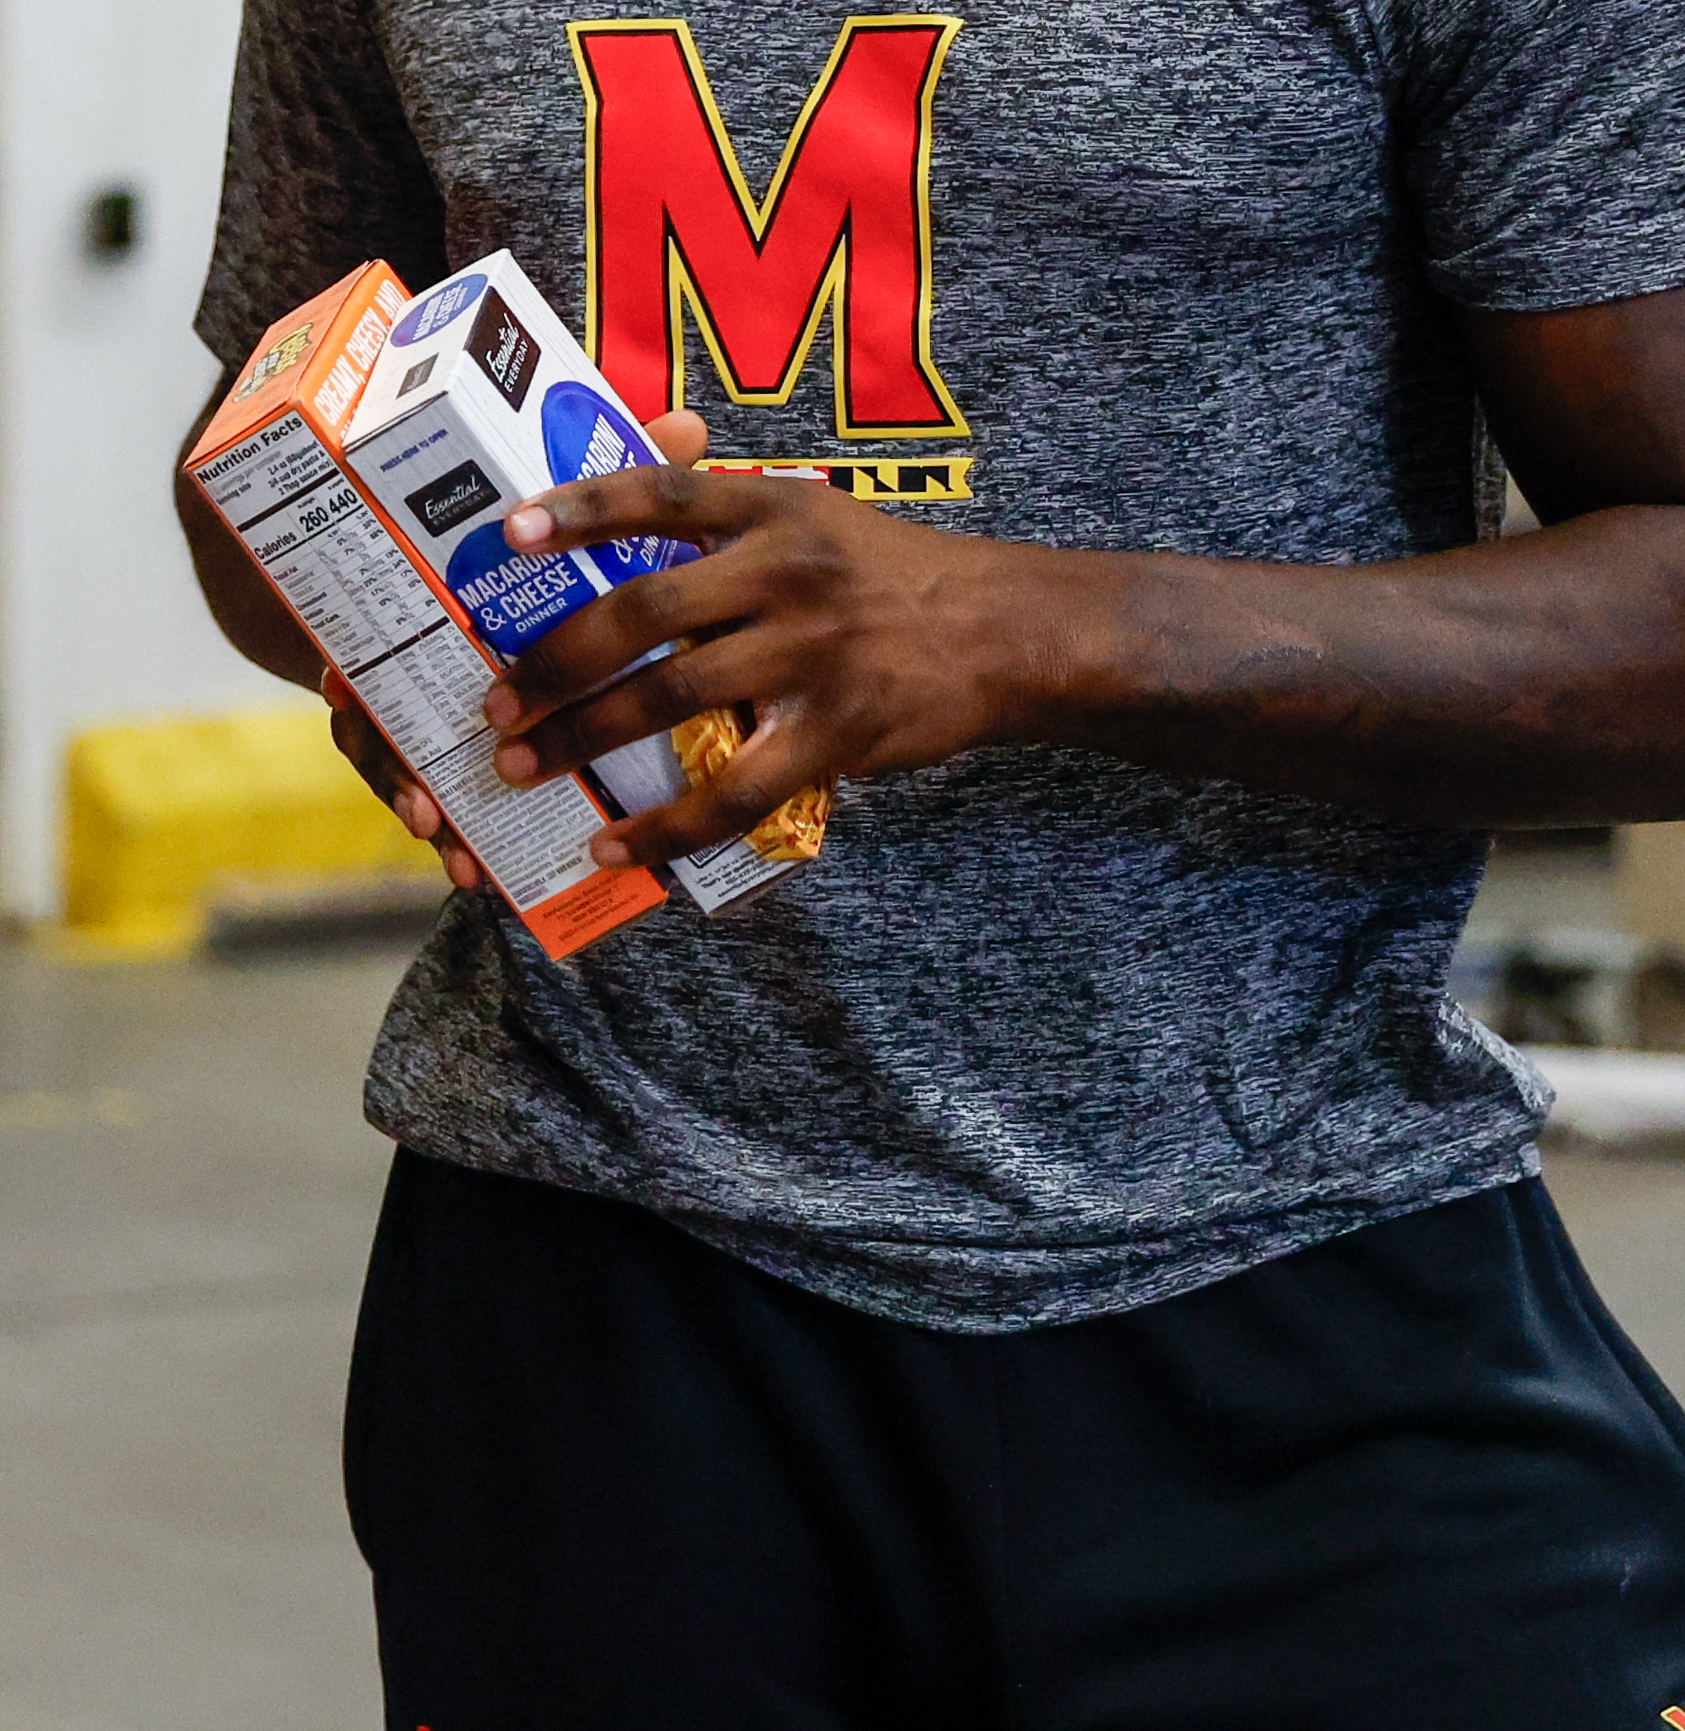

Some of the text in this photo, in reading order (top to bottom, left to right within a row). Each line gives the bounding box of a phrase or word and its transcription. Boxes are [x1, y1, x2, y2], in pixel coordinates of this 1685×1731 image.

[566, 14, 971, 439] M
[313, 356, 366, 424] CREAMY,
[374, 279, 406, 319] AND
[485, 313, 522, 386] Essential
[503, 338, 530, 395] EVERYDAY
[197, 442, 261, 485] Nutrition
[261, 415, 303, 445] Facts
[254, 530, 297, 561] Calories
[299, 506, 327, 533] 260
[327, 489, 358, 516] 440
[425, 476, 482, 519] Essential
[433, 491, 485, 526] EVERYDAY
[458, 553, 563, 609] MACARON
[480, 564, 578, 632] & CHEESE
[514, 597, 568, 634] DINNER
